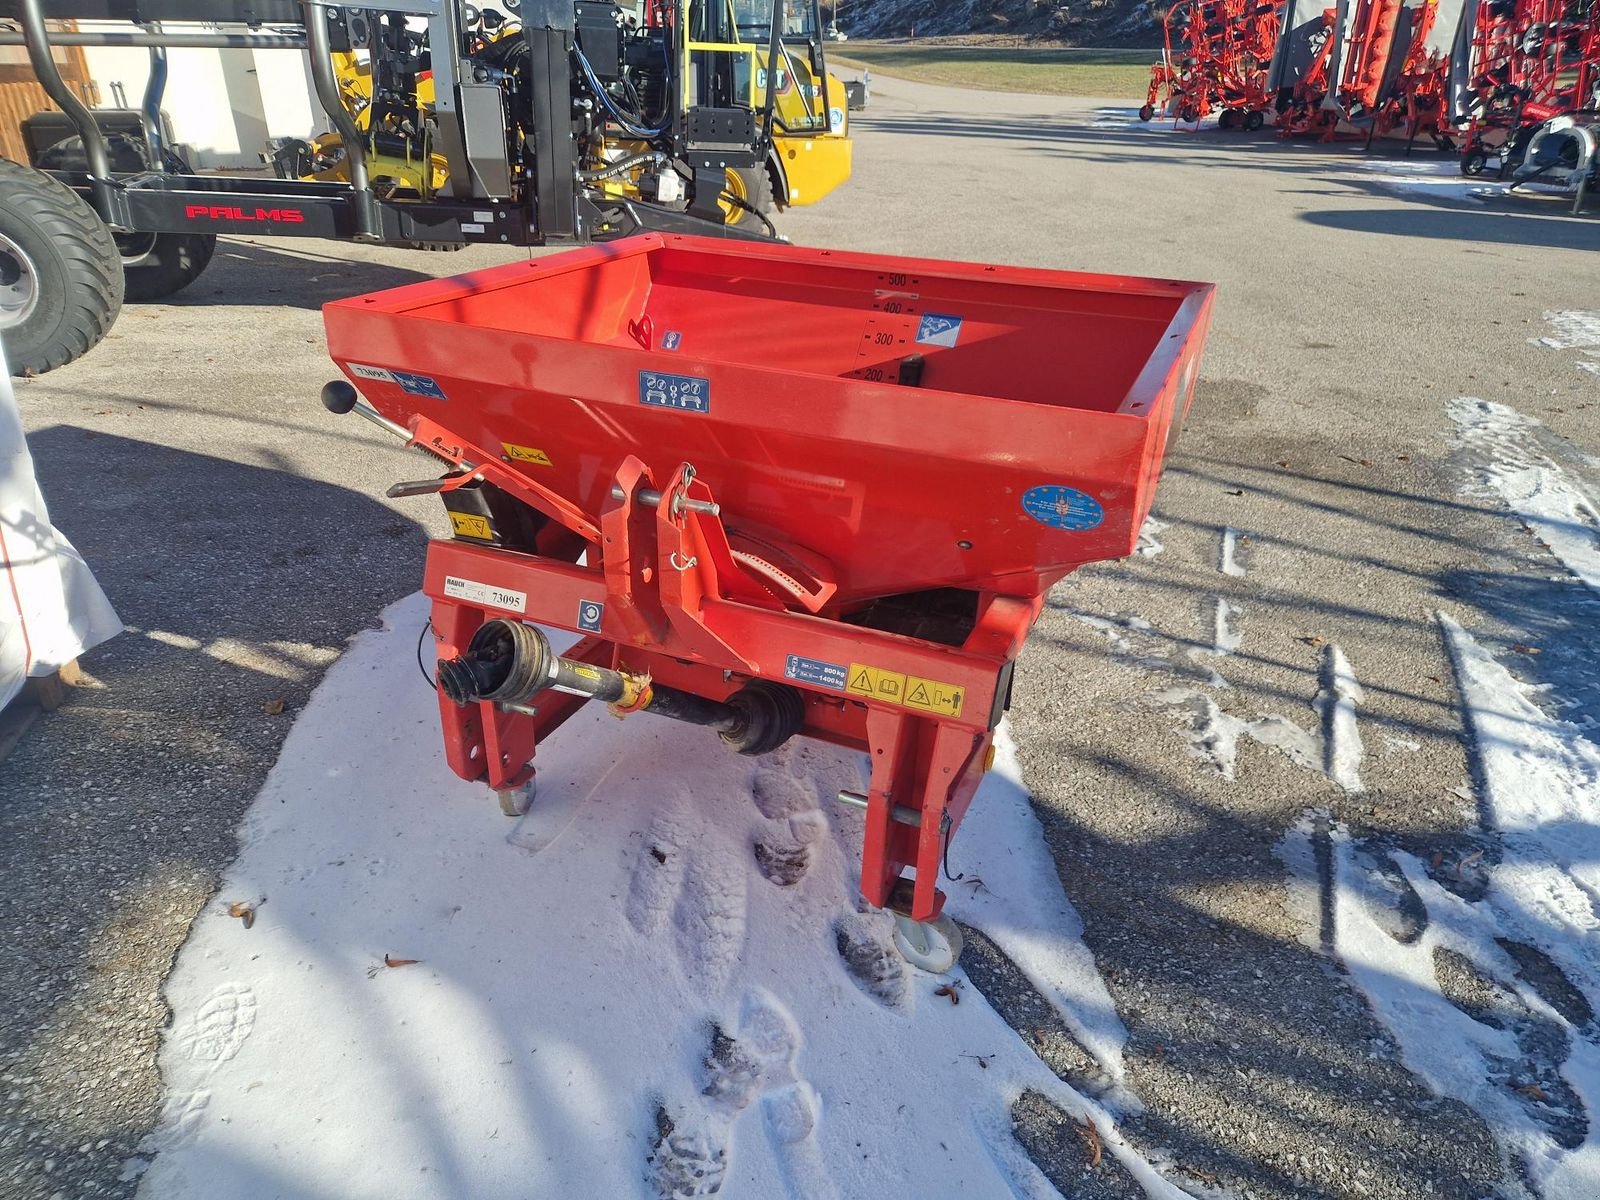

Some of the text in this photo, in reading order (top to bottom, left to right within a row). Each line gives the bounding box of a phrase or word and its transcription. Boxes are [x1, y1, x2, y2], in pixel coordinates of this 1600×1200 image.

[757, 68, 785, 89] CT
[185, 205, 304, 223] PALMS
[889, 272, 907, 286] 500
[884, 302, 902, 315] 400
[875, 332, 893, 346] 300
[864, 368, 883, 382] 200
[446, 578, 465, 588] RAUCH
[492, 591, 521, 607] 73095
